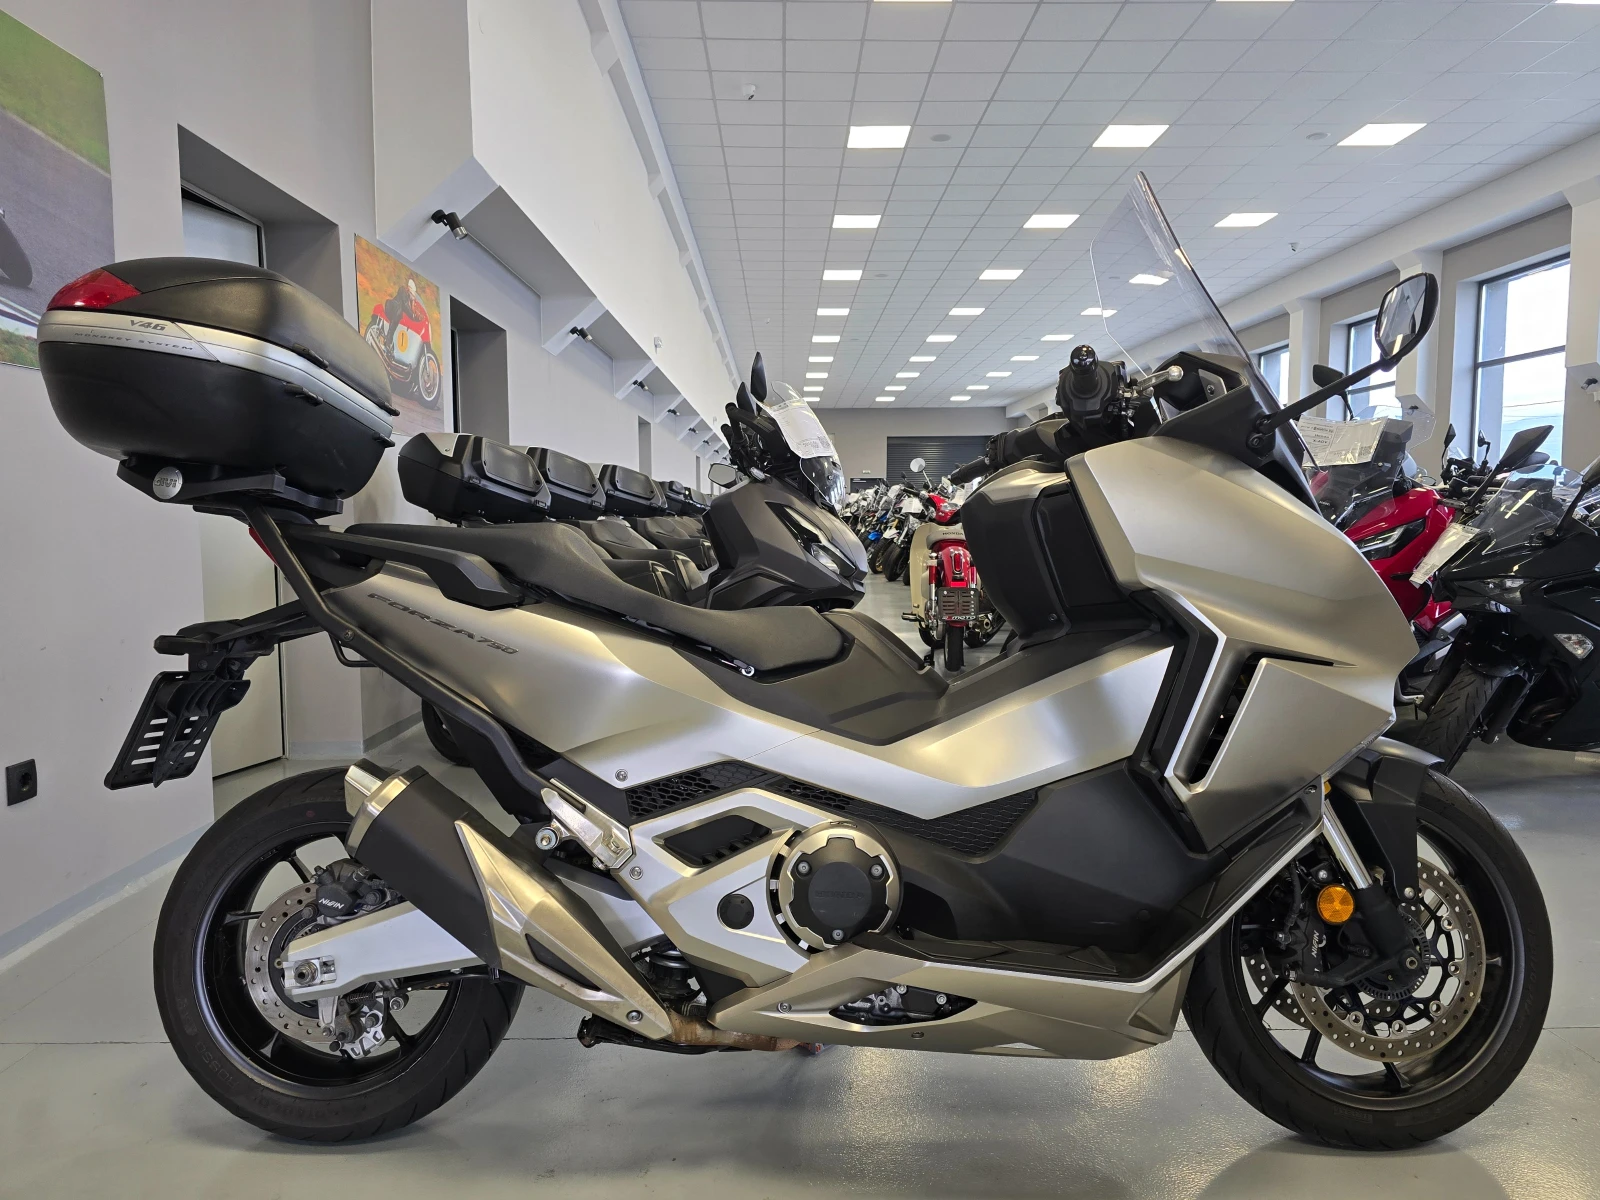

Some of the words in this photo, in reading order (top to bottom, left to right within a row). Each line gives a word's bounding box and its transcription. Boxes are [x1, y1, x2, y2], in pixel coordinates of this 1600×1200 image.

[129, 320, 168, 331] V46
[137, 339, 193, 350] SYSTEM
[367, 592, 476, 640] FORZA
[477, 635, 520, 655] 750
[815, 890, 864, 899] HONDA
[318, 897, 345, 910] NISSIN
